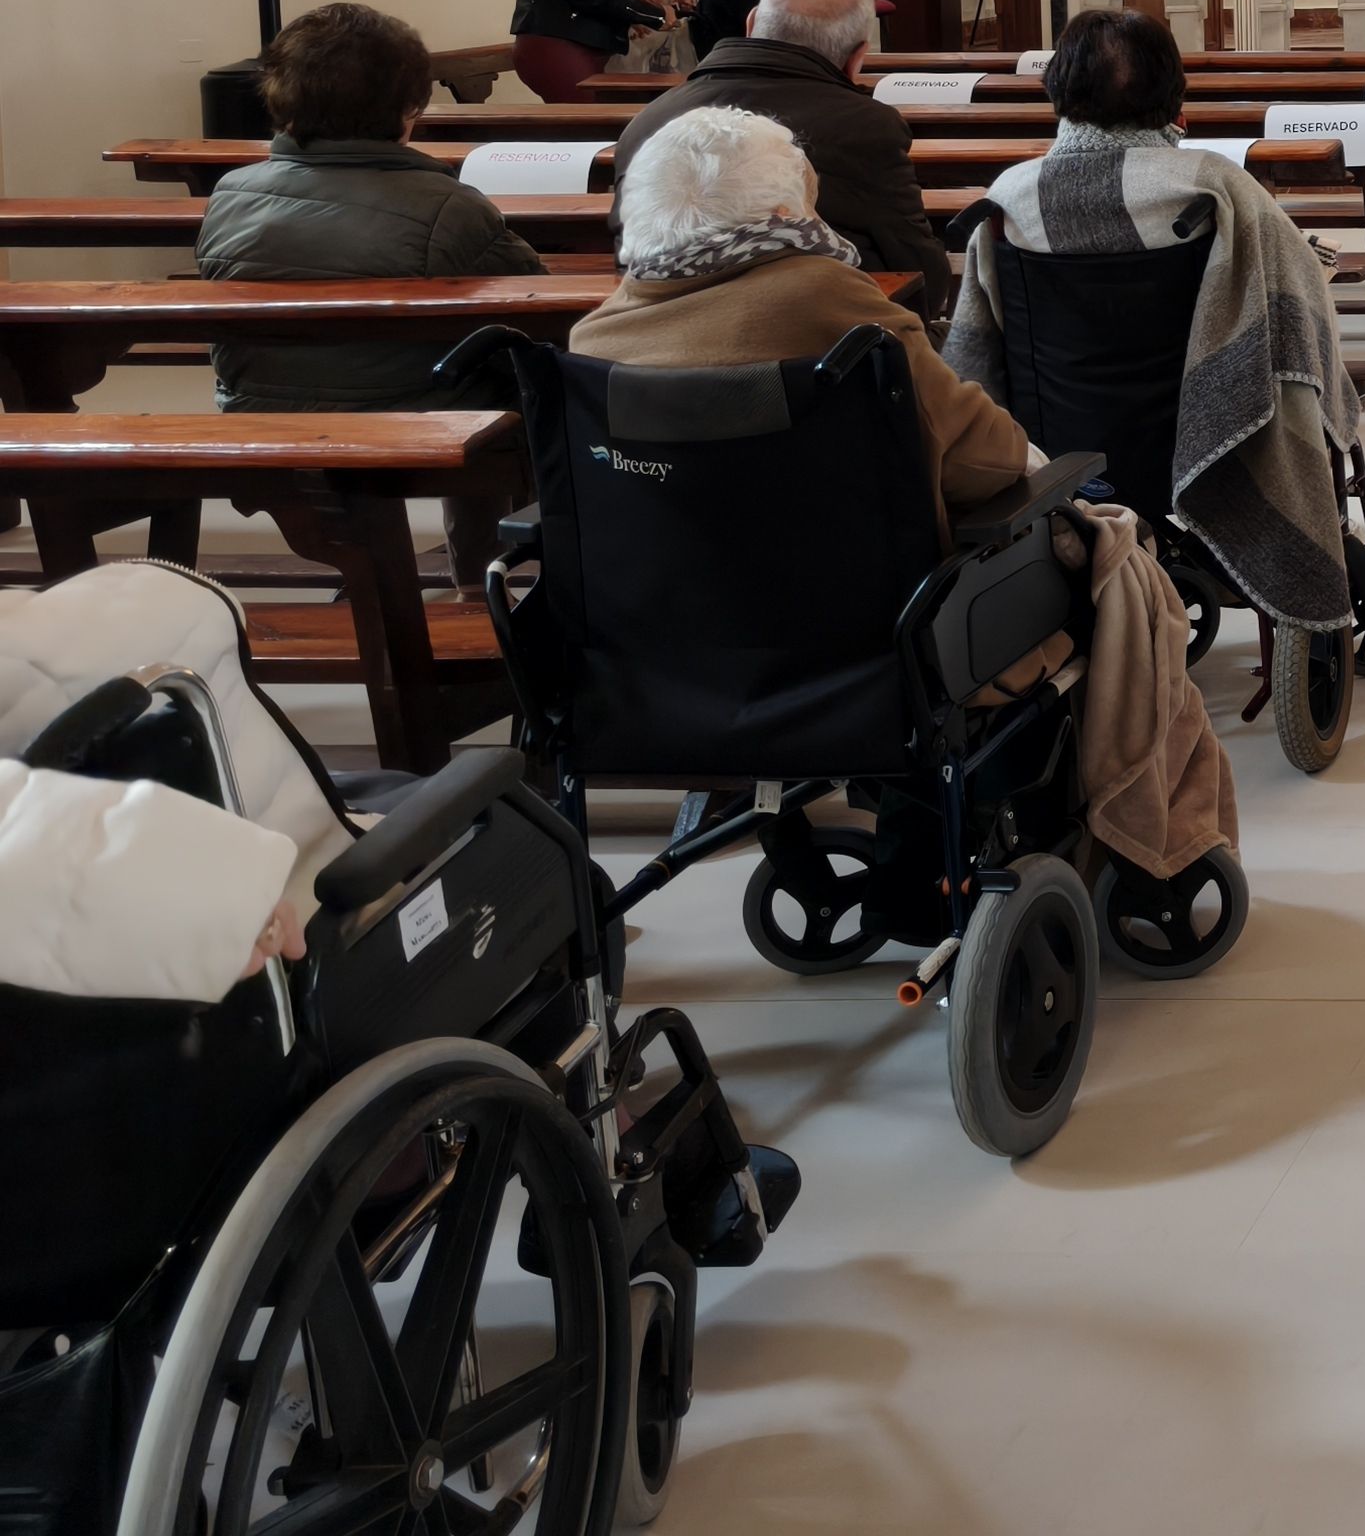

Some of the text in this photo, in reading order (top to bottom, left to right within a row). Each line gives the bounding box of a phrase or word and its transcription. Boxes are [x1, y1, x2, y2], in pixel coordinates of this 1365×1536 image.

[893, 80, 960, 88] RESERVADO
[1283, 120, 1359, 133] RESERVADO
[488, 152, 571, 162] RESERVADO
